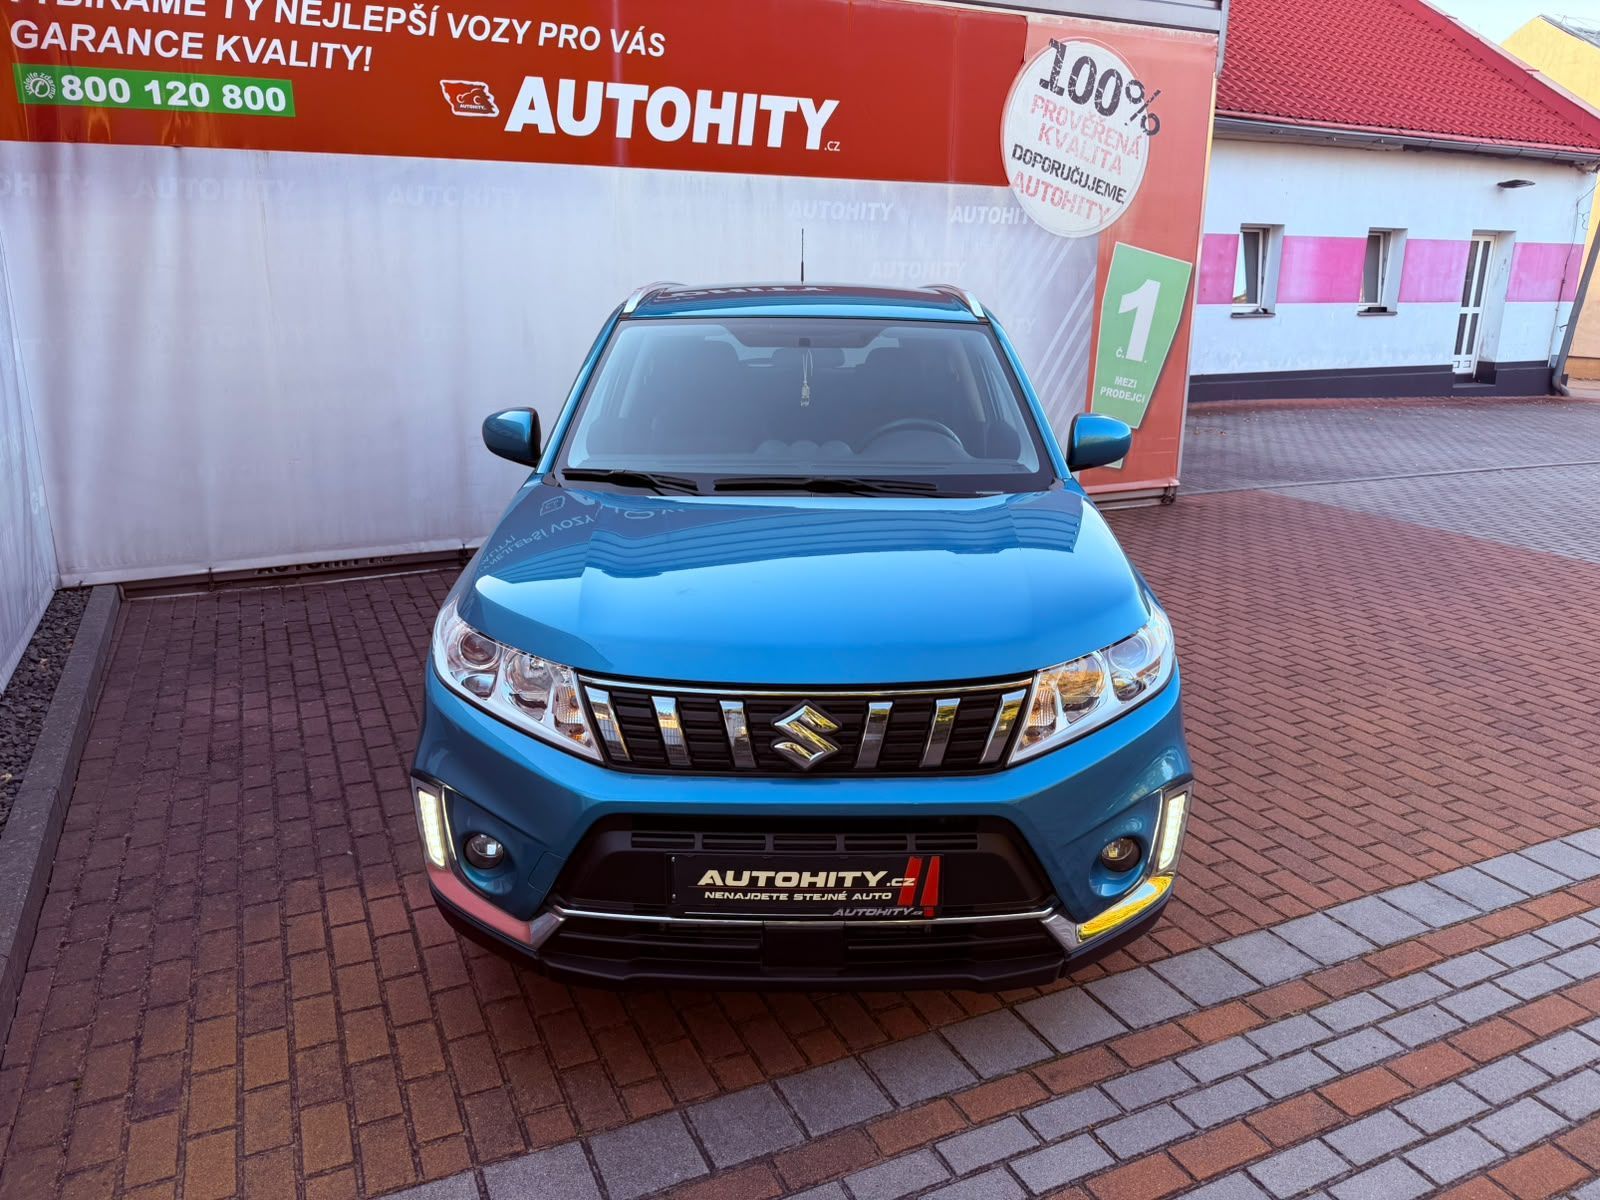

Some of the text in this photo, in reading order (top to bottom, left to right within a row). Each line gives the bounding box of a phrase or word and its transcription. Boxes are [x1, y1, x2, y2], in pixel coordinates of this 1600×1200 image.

[10, 20, 374, 71] GARANCE KVALITY!
[274, 0, 440, 37] NEJLEPŠÍ
[447, 12, 532, 45] VOZY
[538, 21, 601, 52] PRO
[610, 26, 667, 58] VÁS
[61, 75, 287, 112] 800 120 800
[1038, 37, 1162, 136] 100%
[1030, 94, 1143, 160] PROVĚŘENÁ
[1037, 122, 1123, 176] KVALITA
[132, 176, 296, 201] AUTOHITY
[1011, 143, 1127, 205] DOPORUČUJEME
[1012, 170, 1113, 224] AUTOHITY
[790, 199, 895, 221] AUTOHITY
[1100, 386, 1146, 404] PRODEJCI
[1114, 375, 1138, 389] MEZI
[704, 890, 892, 901] NENAJDETE STEJNÉ AUTO
